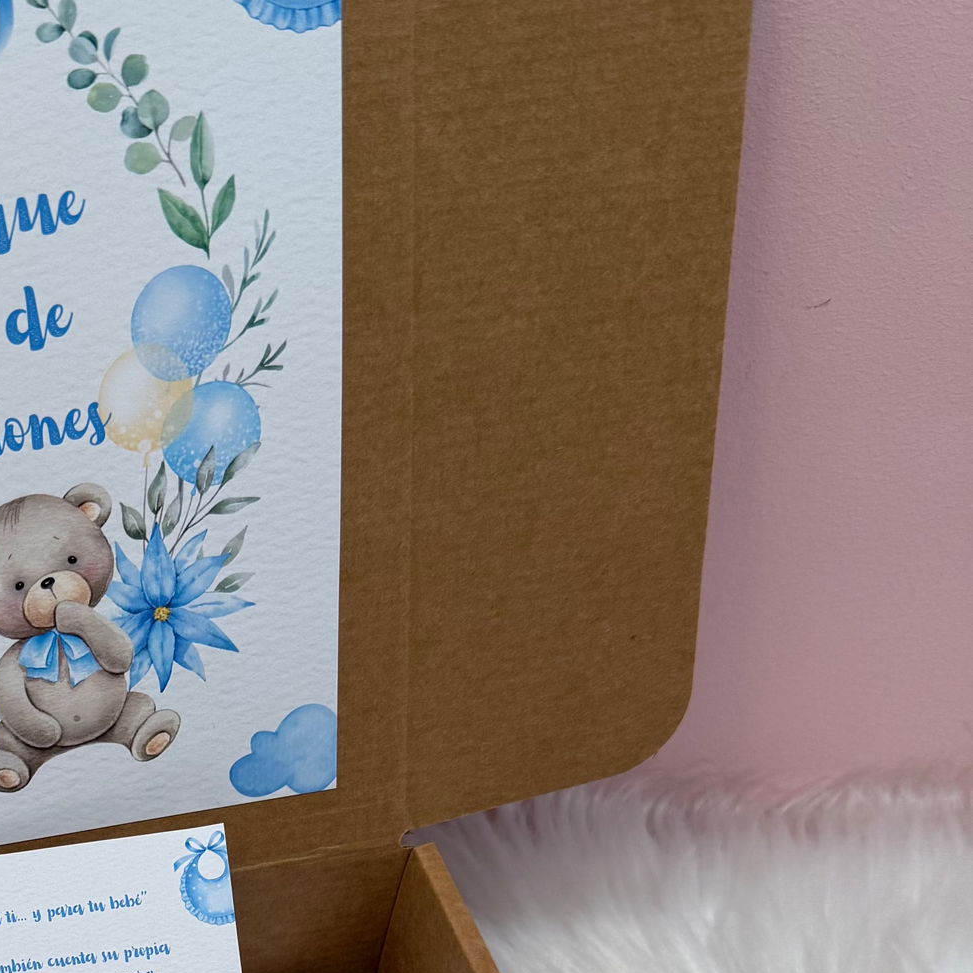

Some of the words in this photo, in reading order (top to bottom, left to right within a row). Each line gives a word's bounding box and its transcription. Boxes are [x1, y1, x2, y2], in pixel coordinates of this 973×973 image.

[5, 286, 73, 352] de
[32, 910, 42, 922] y
[47, 904, 84, 922] para
[87, 901, 105, 912] tu
[48, 953, 97, 967] cuenta
[102, 951, 118, 963] su
[124, 943, 171, 963] propia
